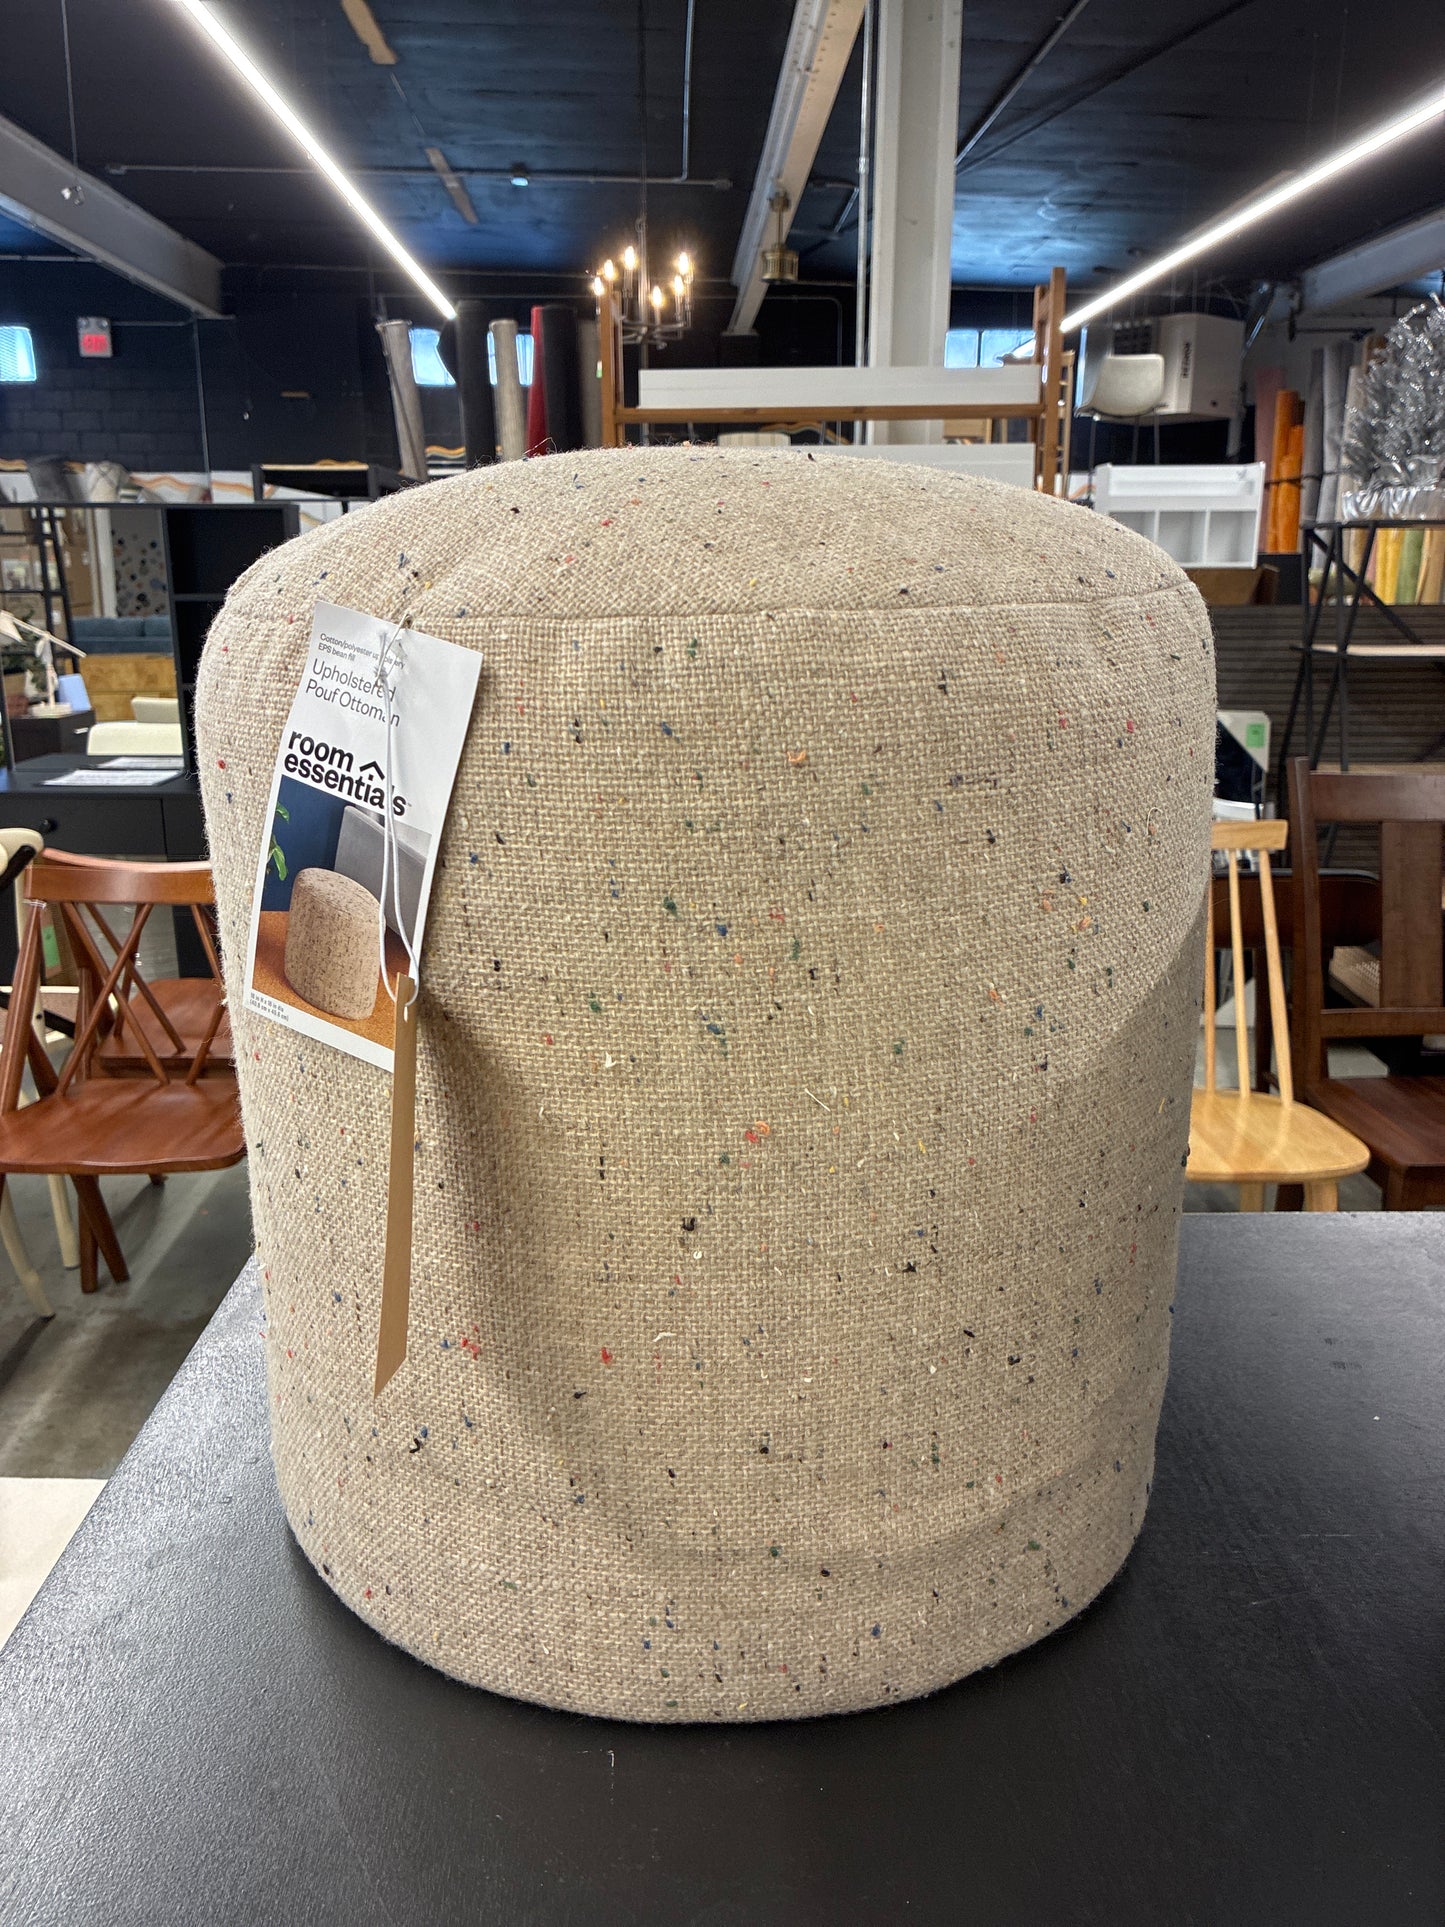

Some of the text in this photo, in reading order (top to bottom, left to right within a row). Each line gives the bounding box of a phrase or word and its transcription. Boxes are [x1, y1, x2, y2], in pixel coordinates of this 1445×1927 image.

[318, 642, 332, 654] EPS
[332, 648, 347, 659] bean
[320, 633, 406, 670] Cotton/polyester upolsery
[306, 678, 340, 703] Pouf
[312, 658, 396, 702] Upholstered
[288, 731, 354, 772] room
[284, 753, 407, 816] essentias
